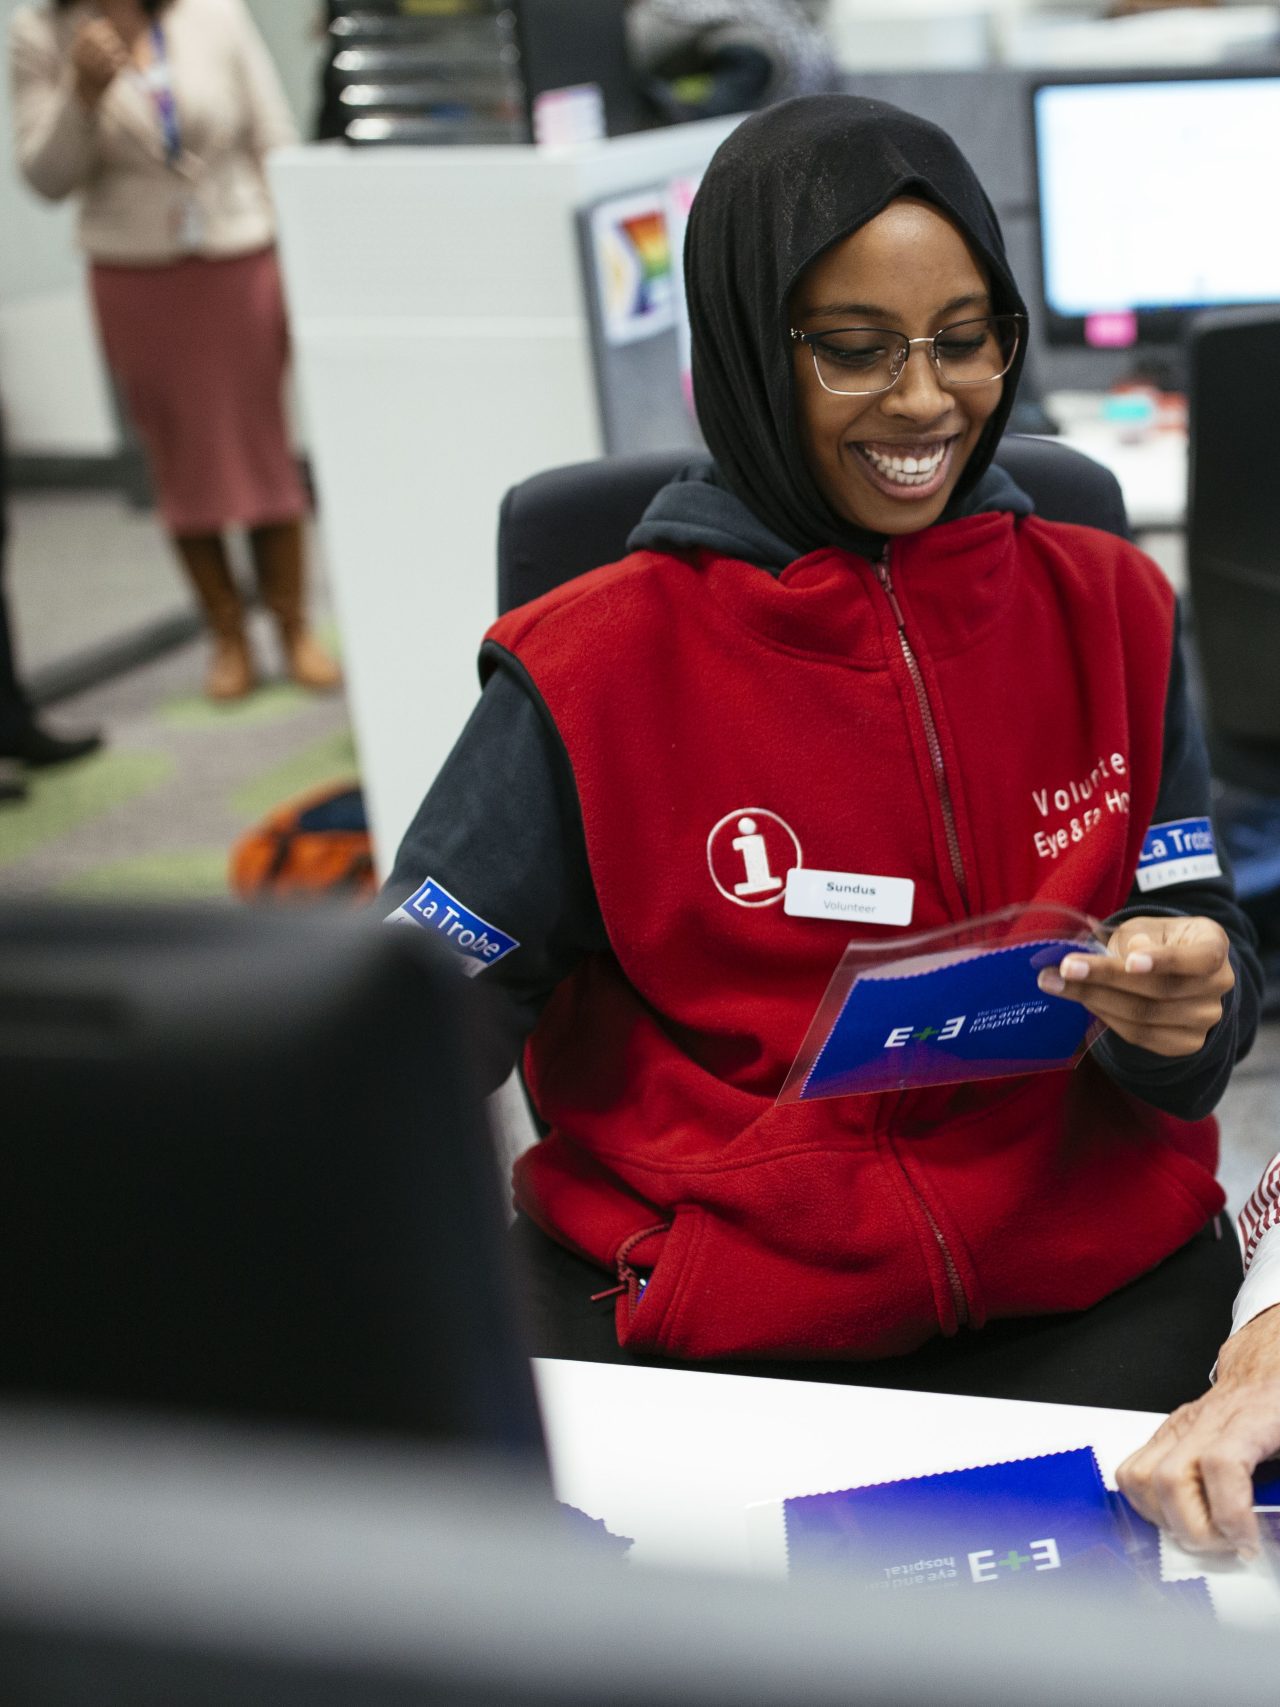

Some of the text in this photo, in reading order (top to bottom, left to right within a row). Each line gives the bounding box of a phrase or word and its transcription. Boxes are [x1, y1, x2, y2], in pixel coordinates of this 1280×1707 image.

[1033, 828, 1068, 859] Eye
[1069, 818, 1084, 843] &
[826, 881, 876, 896] Sundus
[823, 899, 876, 915] Volunteer
[411, 887, 501, 958] La Trobe
[968, 1013, 1026, 1034] hospital
